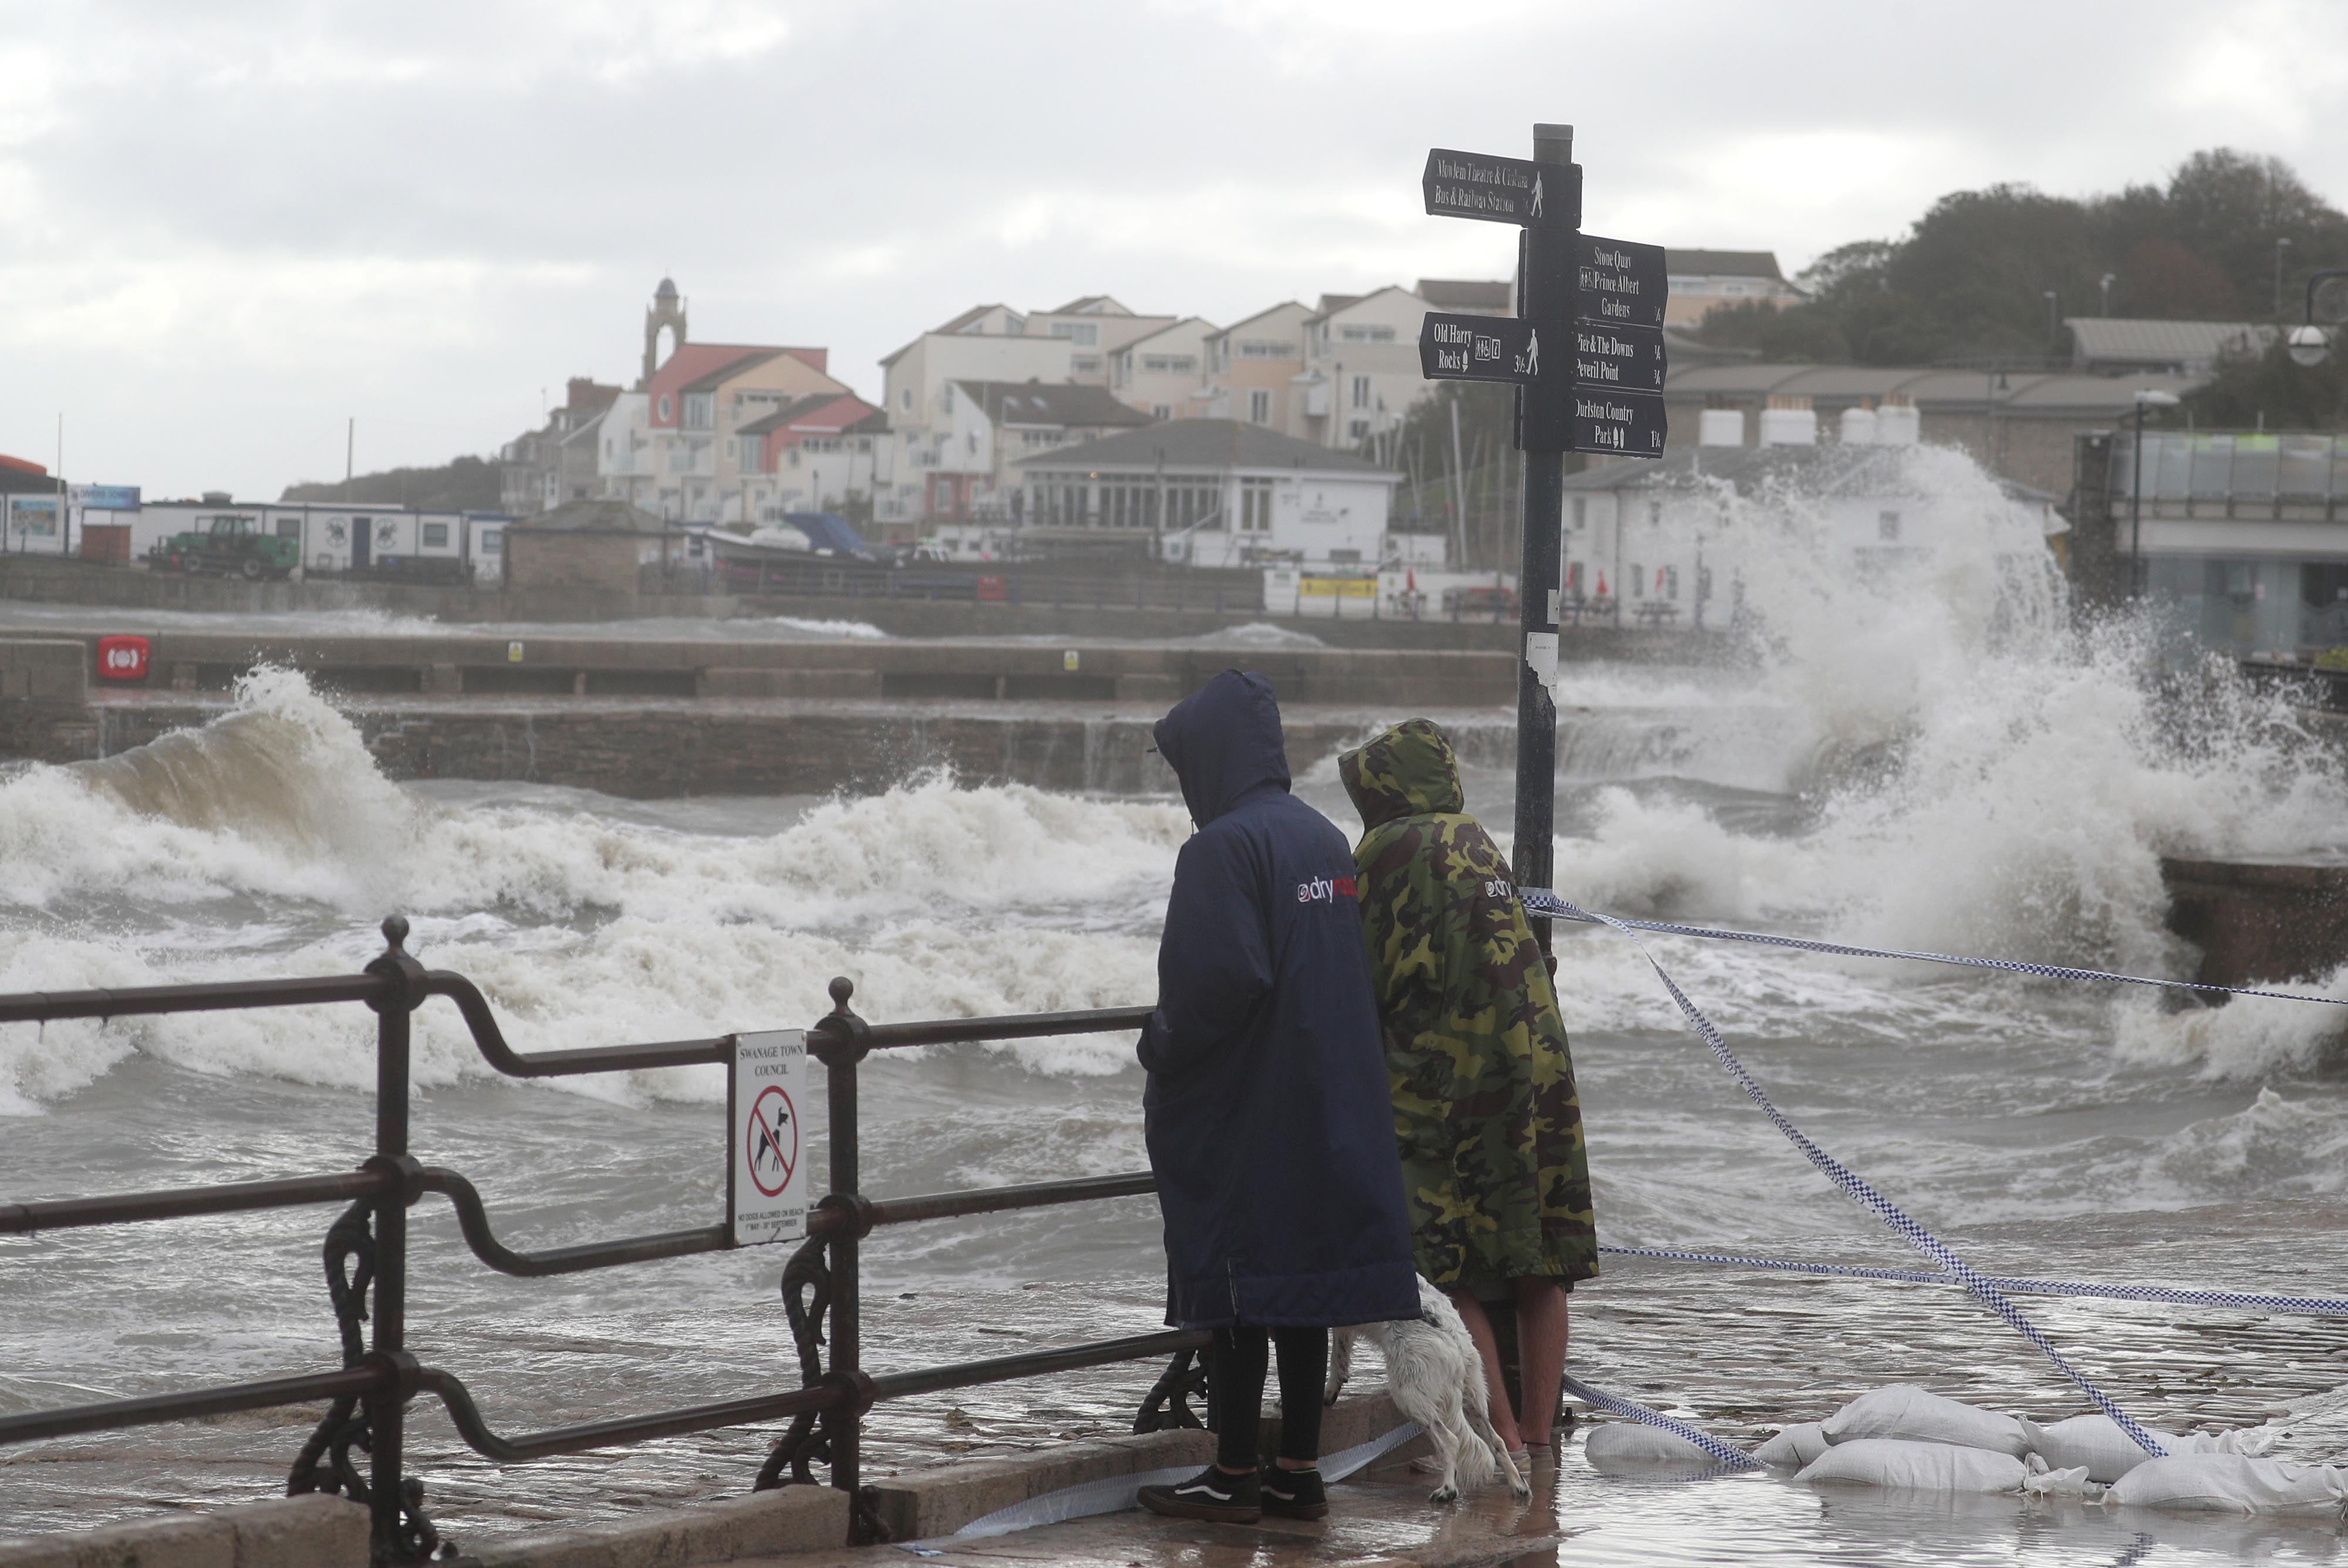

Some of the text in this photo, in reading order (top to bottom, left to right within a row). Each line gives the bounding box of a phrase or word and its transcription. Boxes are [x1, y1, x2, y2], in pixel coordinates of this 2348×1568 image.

[1437, 159, 1528, 188] Mowlem Theatre & Cinema
[1435, 185, 1514, 213] Bus & Railway Station
[1594, 247, 1631, 272] Stone Quay
[1594, 271, 1639, 295] Prince Albert
[1601, 297, 1630, 318] Gardens
[1434, 323, 1473, 348] Old Harry
[1590, 335, 1596, 353] &
[1597, 336, 1610, 354] The
[1611, 336, 1634, 358] Downs
[1438, 349, 1460, 369] Rocks
[1601, 361, 1619, 381] Point
[1606, 402, 1634, 424] Country
[1594, 425, 1612, 444] Park
[740, 1044, 804, 1060] SWANAGE TOWN
[754, 1063, 789, 1077] COUNCIL
[738, 1213, 745, 1222] NO
[745, 1212, 758, 1221] DOGS
[760, 1210, 780, 1219] ALLOWED
[788, 1208, 804, 1216] BEACH
[771, 1219, 797, 1229] SEPTEMBER
[1853, 1270, 1931, 1284] COASTGUARD
